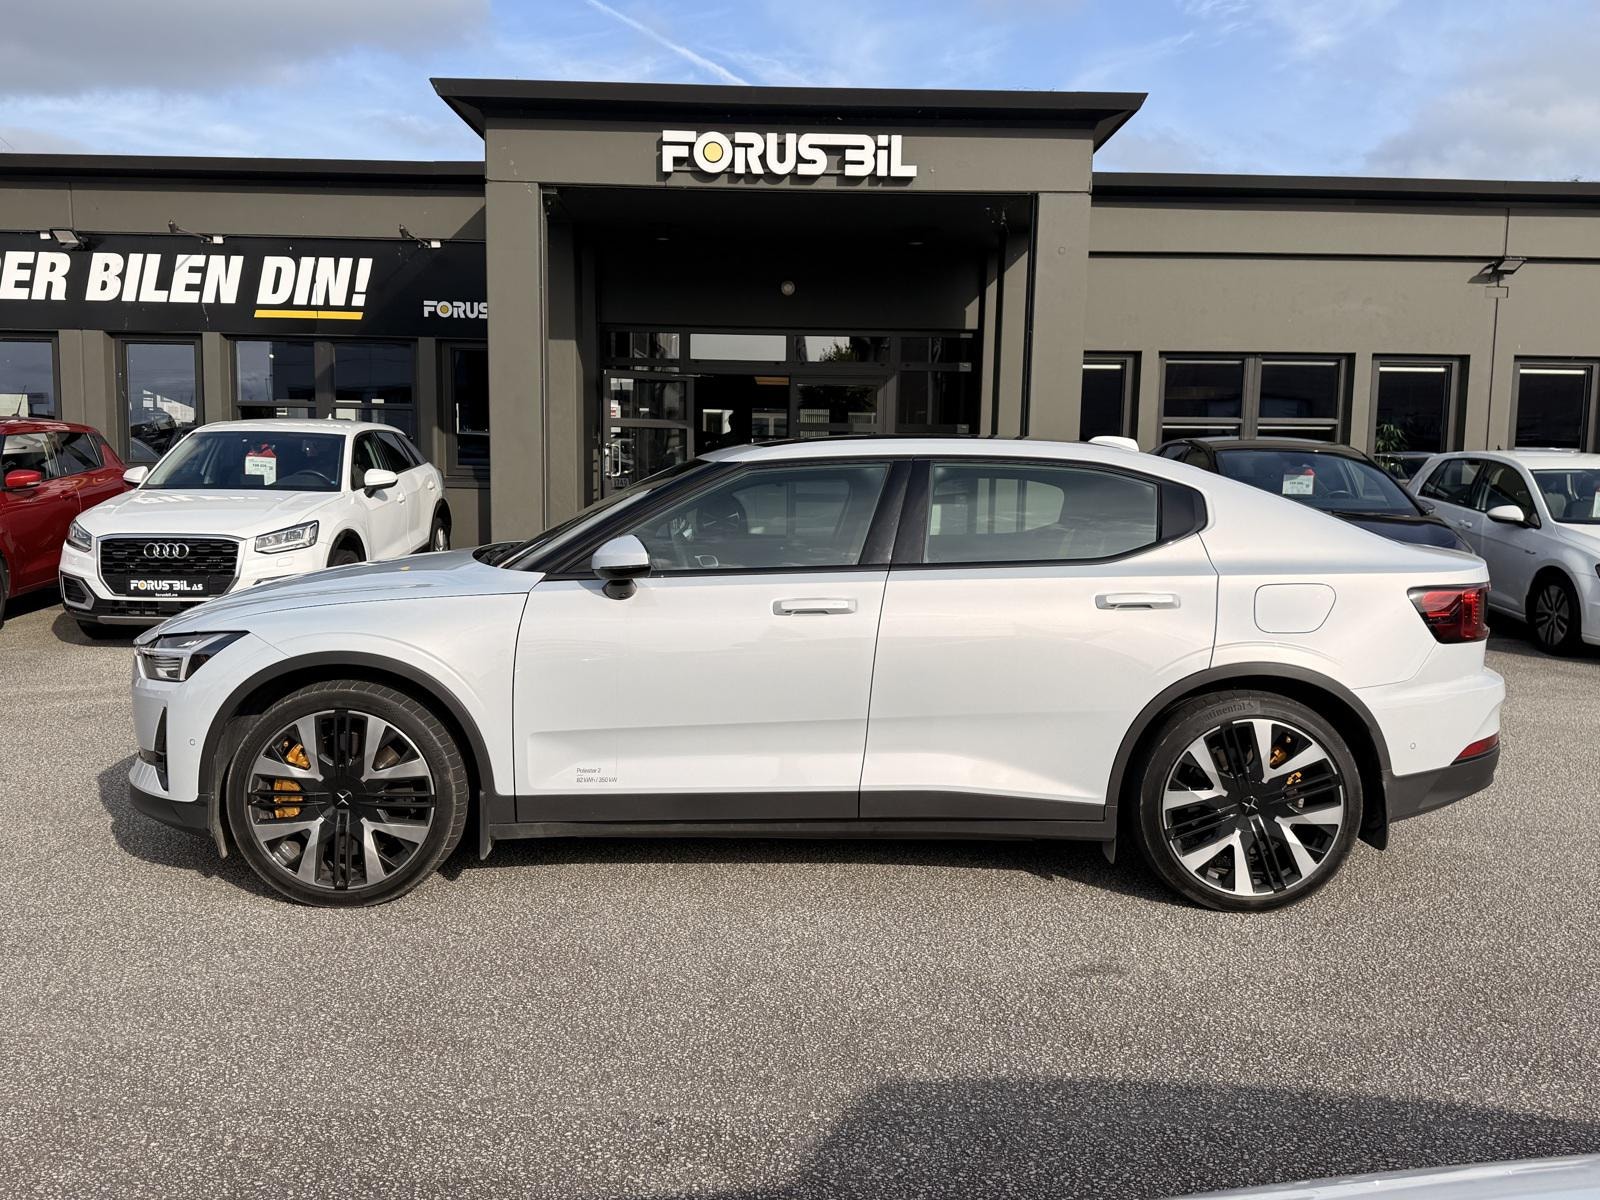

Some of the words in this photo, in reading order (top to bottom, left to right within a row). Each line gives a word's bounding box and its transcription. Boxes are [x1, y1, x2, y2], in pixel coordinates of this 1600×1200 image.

[662, 130, 827, 175] FORUS
[0, 251, 71, 300] ER
[85, 252, 244, 304] BILEN
[256, 256, 373, 307] DIN!
[423, 300, 488, 319] FORUS
[130, 580, 170, 591] FORUS
[192, 583, 203, 591] AS
